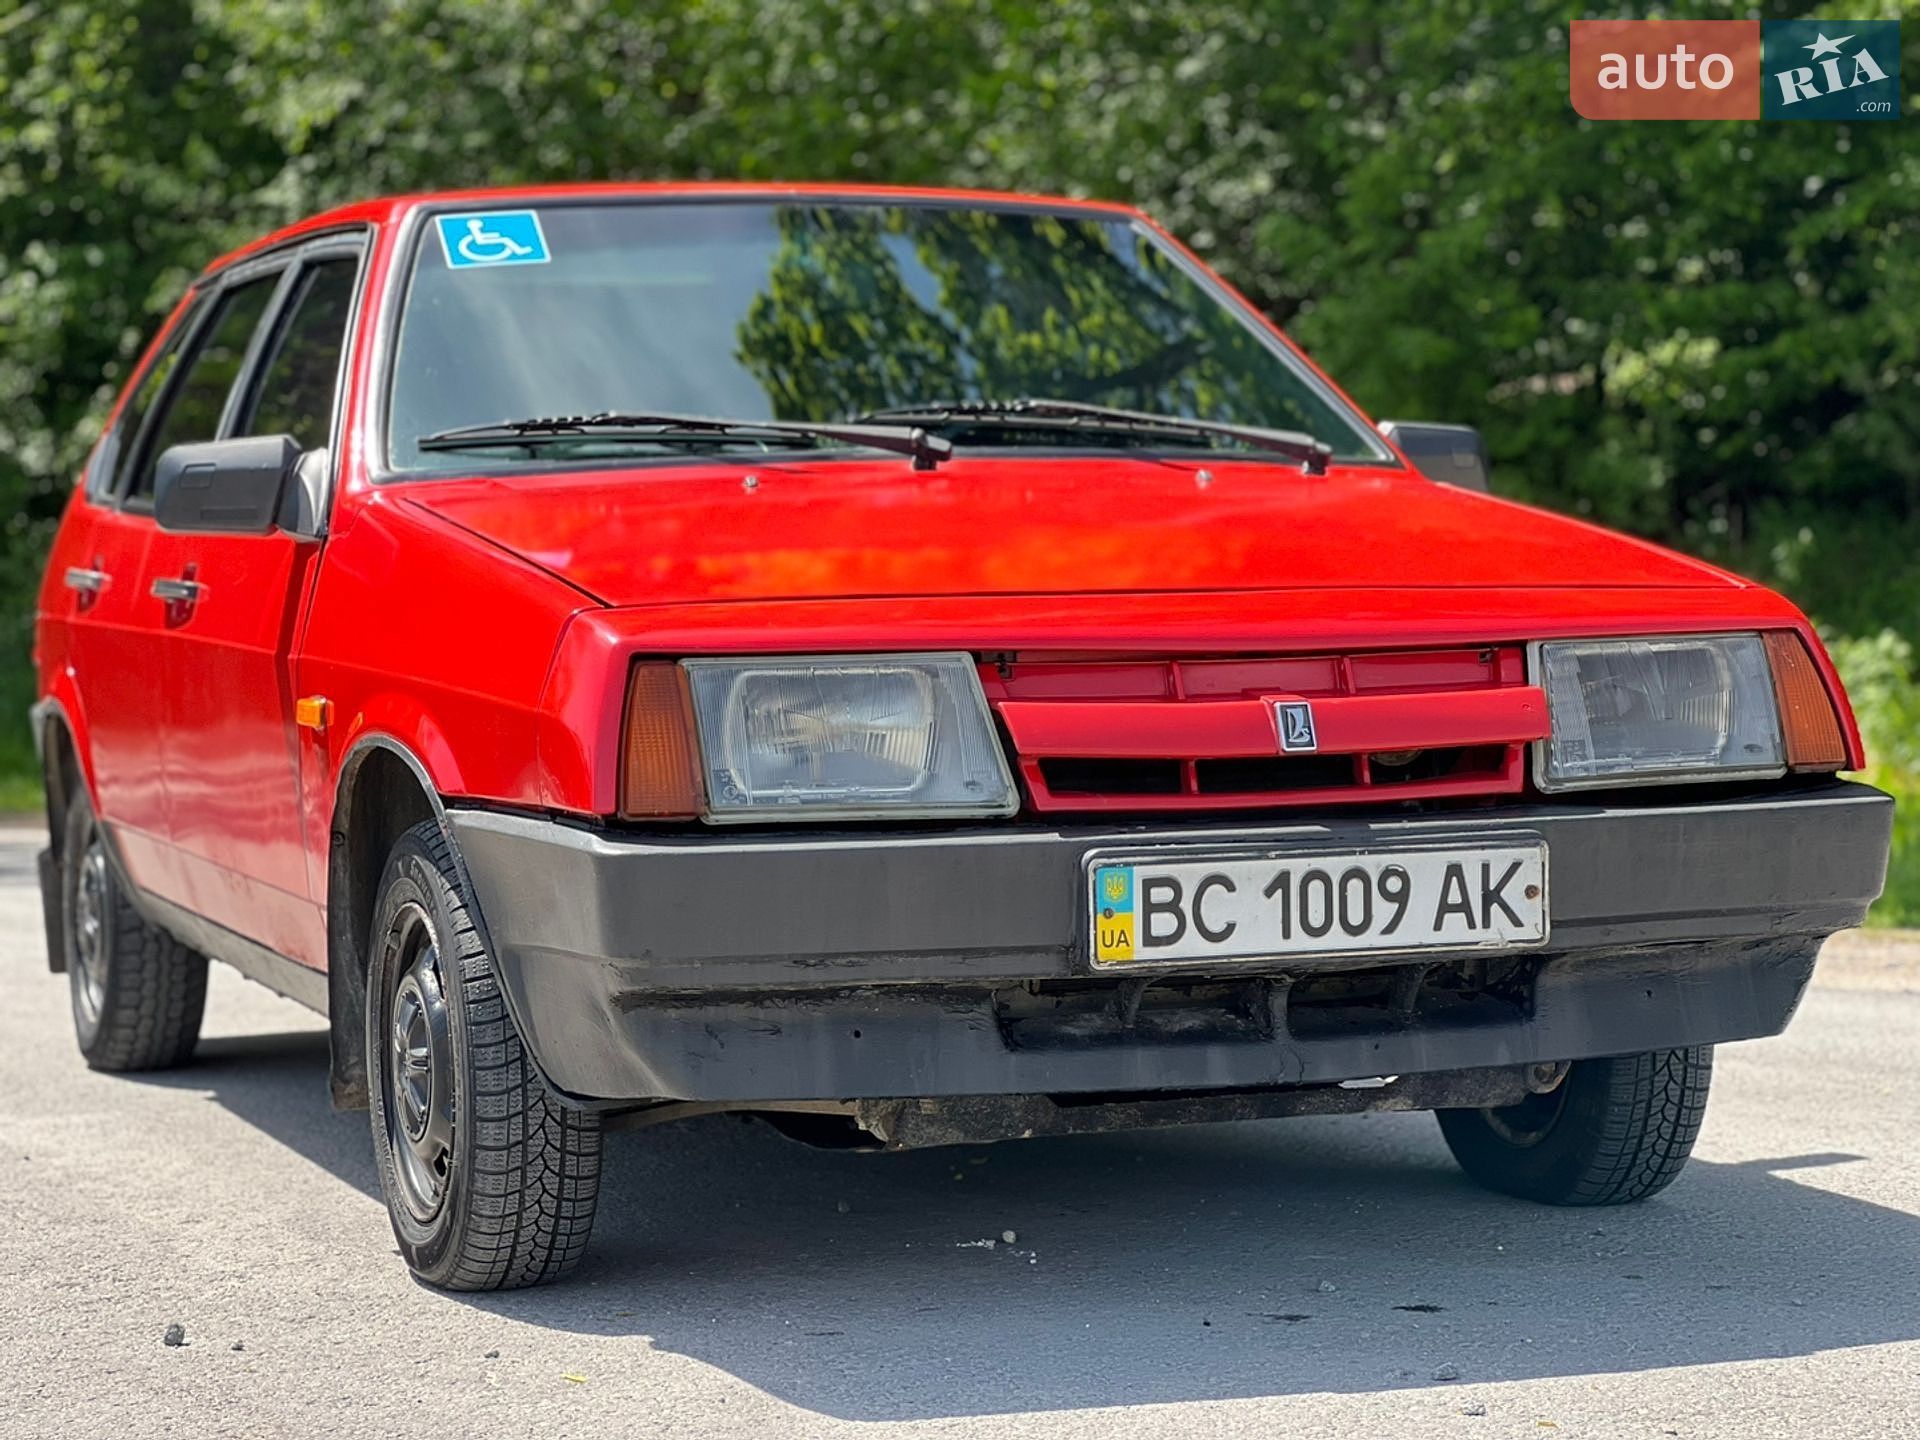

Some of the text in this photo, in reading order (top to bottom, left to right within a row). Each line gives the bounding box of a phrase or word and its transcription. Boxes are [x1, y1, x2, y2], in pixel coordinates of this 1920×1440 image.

[1141, 861, 1524, 947] BC 1009 AK
[1102, 930, 1130, 948] UA
